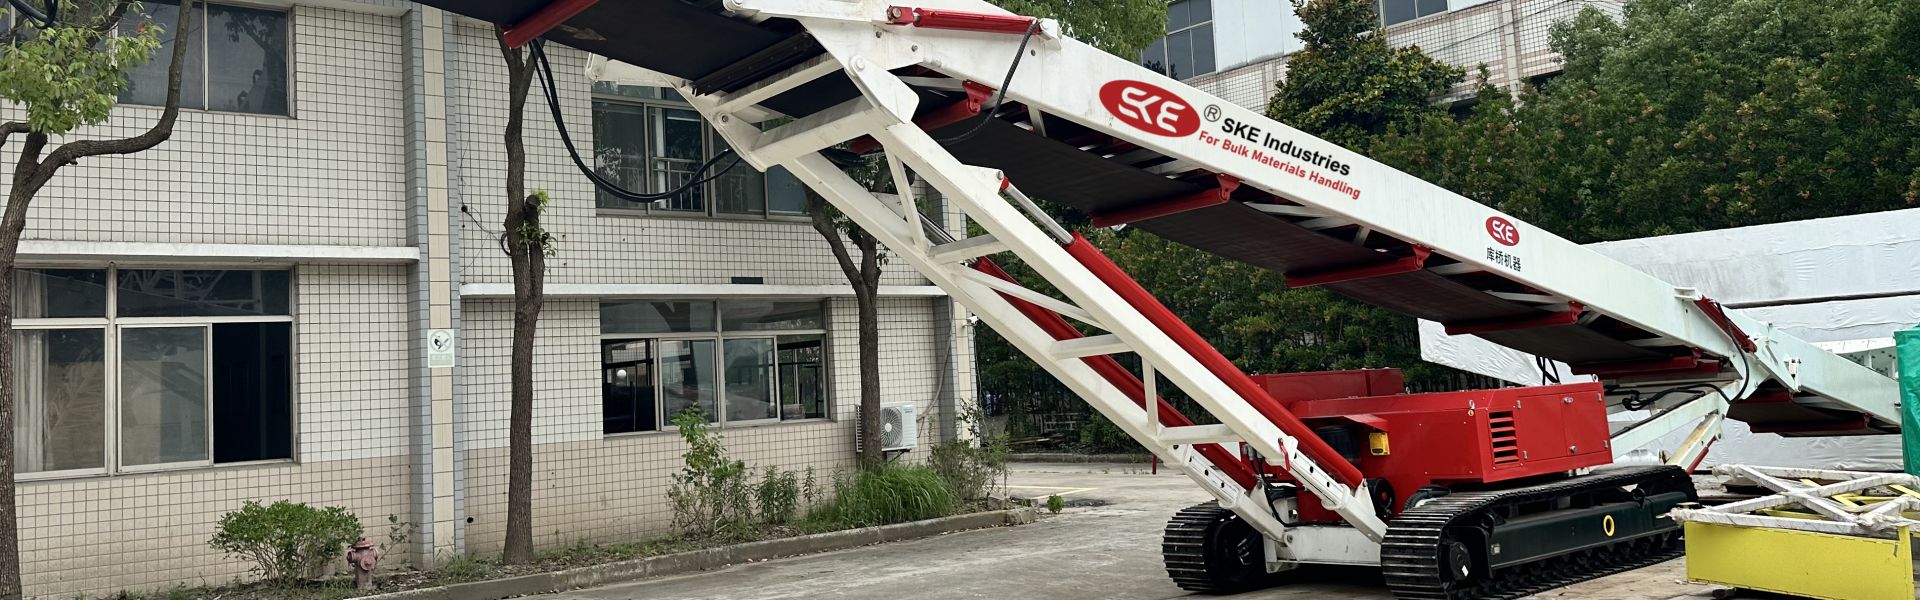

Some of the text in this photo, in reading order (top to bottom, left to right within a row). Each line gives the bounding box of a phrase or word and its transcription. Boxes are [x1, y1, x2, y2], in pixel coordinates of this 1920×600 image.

[1118, 86, 1186, 133] SKE
[1198, 130, 1361, 201] For Bulk Materials Handling
[1221, 117, 1351, 176] SKE Industries
[1492, 219, 1514, 244] SKE
[1486, 246, 1522, 272] 库桥机器
